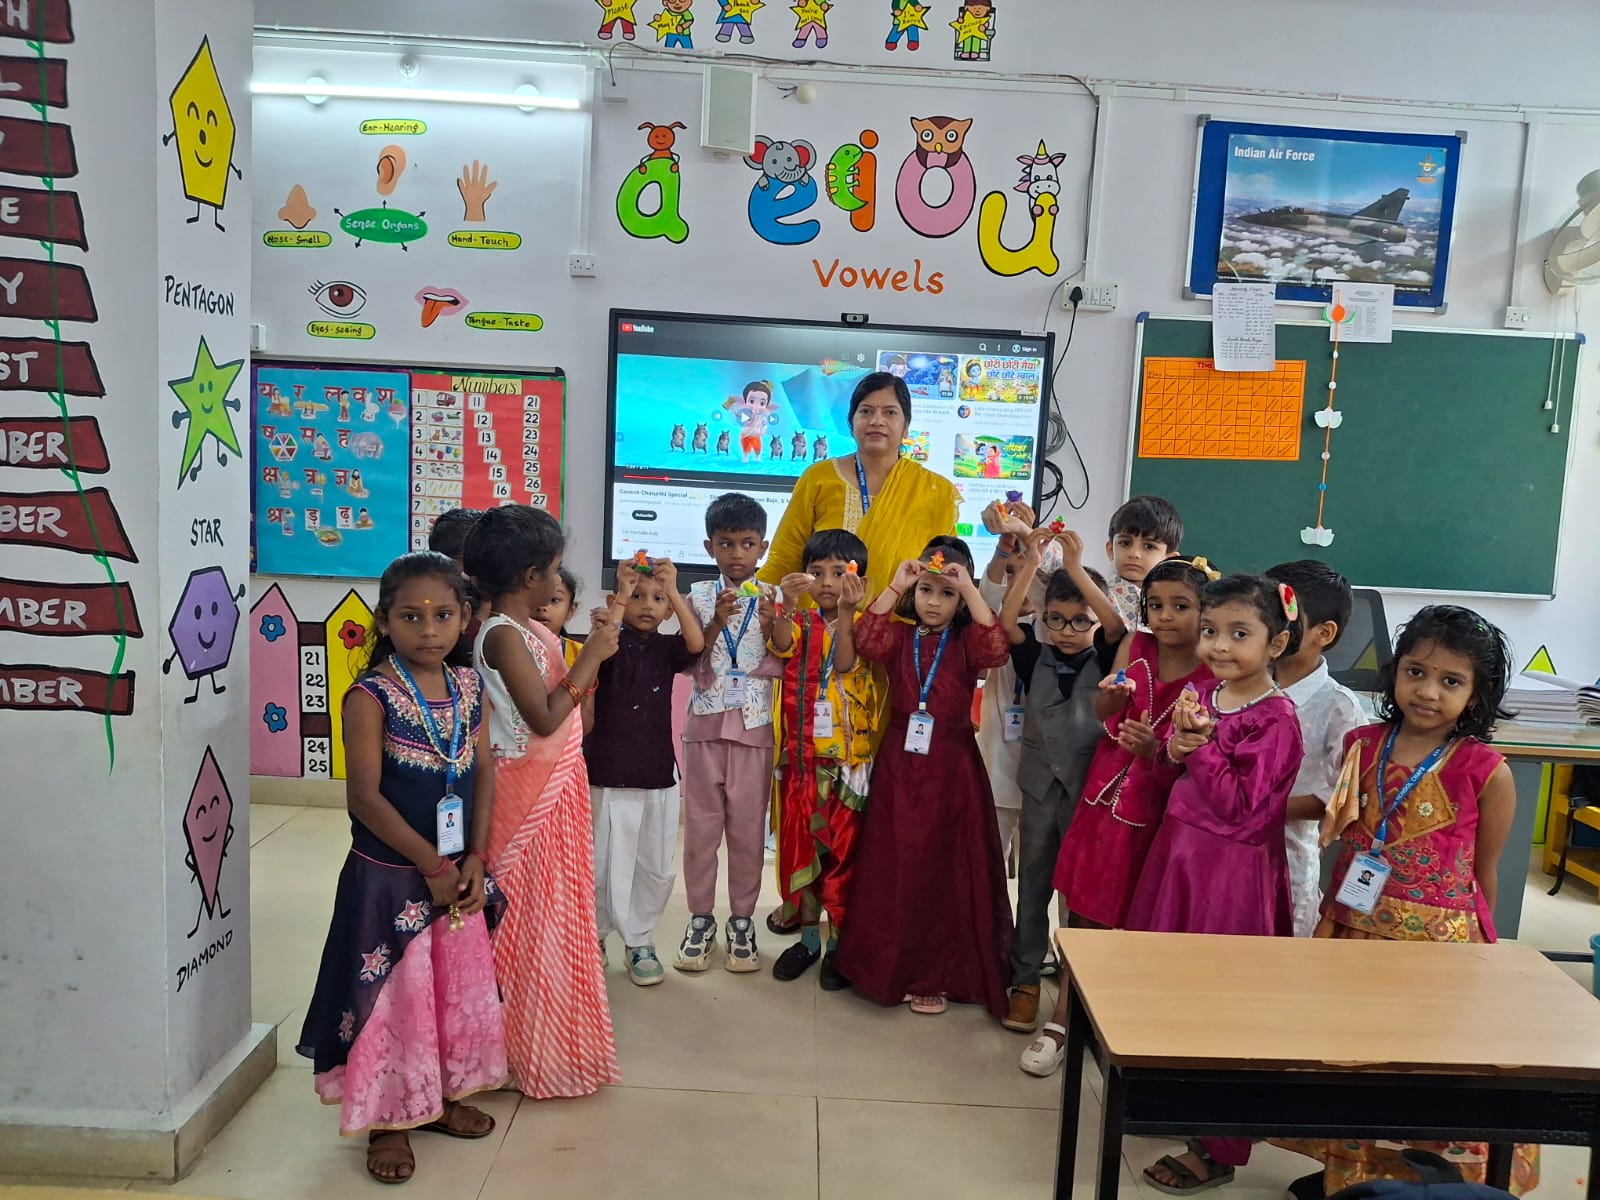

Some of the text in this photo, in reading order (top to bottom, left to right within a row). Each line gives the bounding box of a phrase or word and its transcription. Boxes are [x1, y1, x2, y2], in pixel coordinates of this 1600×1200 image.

[1234, 145, 1316, 162] Indian Air Force
[616, 156, 690, 244] a
[748, 171, 820, 245] e
[850, 129, 879, 233] i
[977, 191, 1060, 277] u
[345, 217, 420, 232] Sense Organs
[812, 258, 944, 294] Vowels
[164, 275, 235, 317] PENTAGON
[452, 376, 517, 394] Numbers
[292, 384, 305, 401] र
[323, 386, 343, 402] ल
[351, 387, 368, 404] व
[472, 396, 481, 407] 11
[527, 397, 538, 407] 21
[415, 411, 423, 421] 2
[477, 415, 488, 425] 12
[524, 413, 539, 424] 22
[336, 429, 352, 449] ह
[415, 428, 422, 439] 3
[481, 432, 491, 443] 13
[524, 429, 538, 440] 23
[415, 446, 422, 457] 4
[486, 450, 498, 460] 14
[523, 445, 538, 456] 24
[415, 464, 422, 475] 5
[525, 462, 539, 472] 25
[492, 468, 503, 478] 15
[414, 482, 422, 493] 6
[526, 478, 540, 489] 26
[496, 485, 508, 495] 16
[414, 500, 421, 511] 7
[532, 495, 546, 505] 27
[414, 519, 420, 528] 8
[191, 518, 224, 547] STAR
[414, 538, 421, 547] 9
[304, 651, 321, 666] 21
[305, 673, 326, 688] 22
[304, 694, 325, 708] 23
[307, 740, 328, 755] 24
[308, 758, 328, 773] 25
[176, 930, 233, 992] DIAMOND
